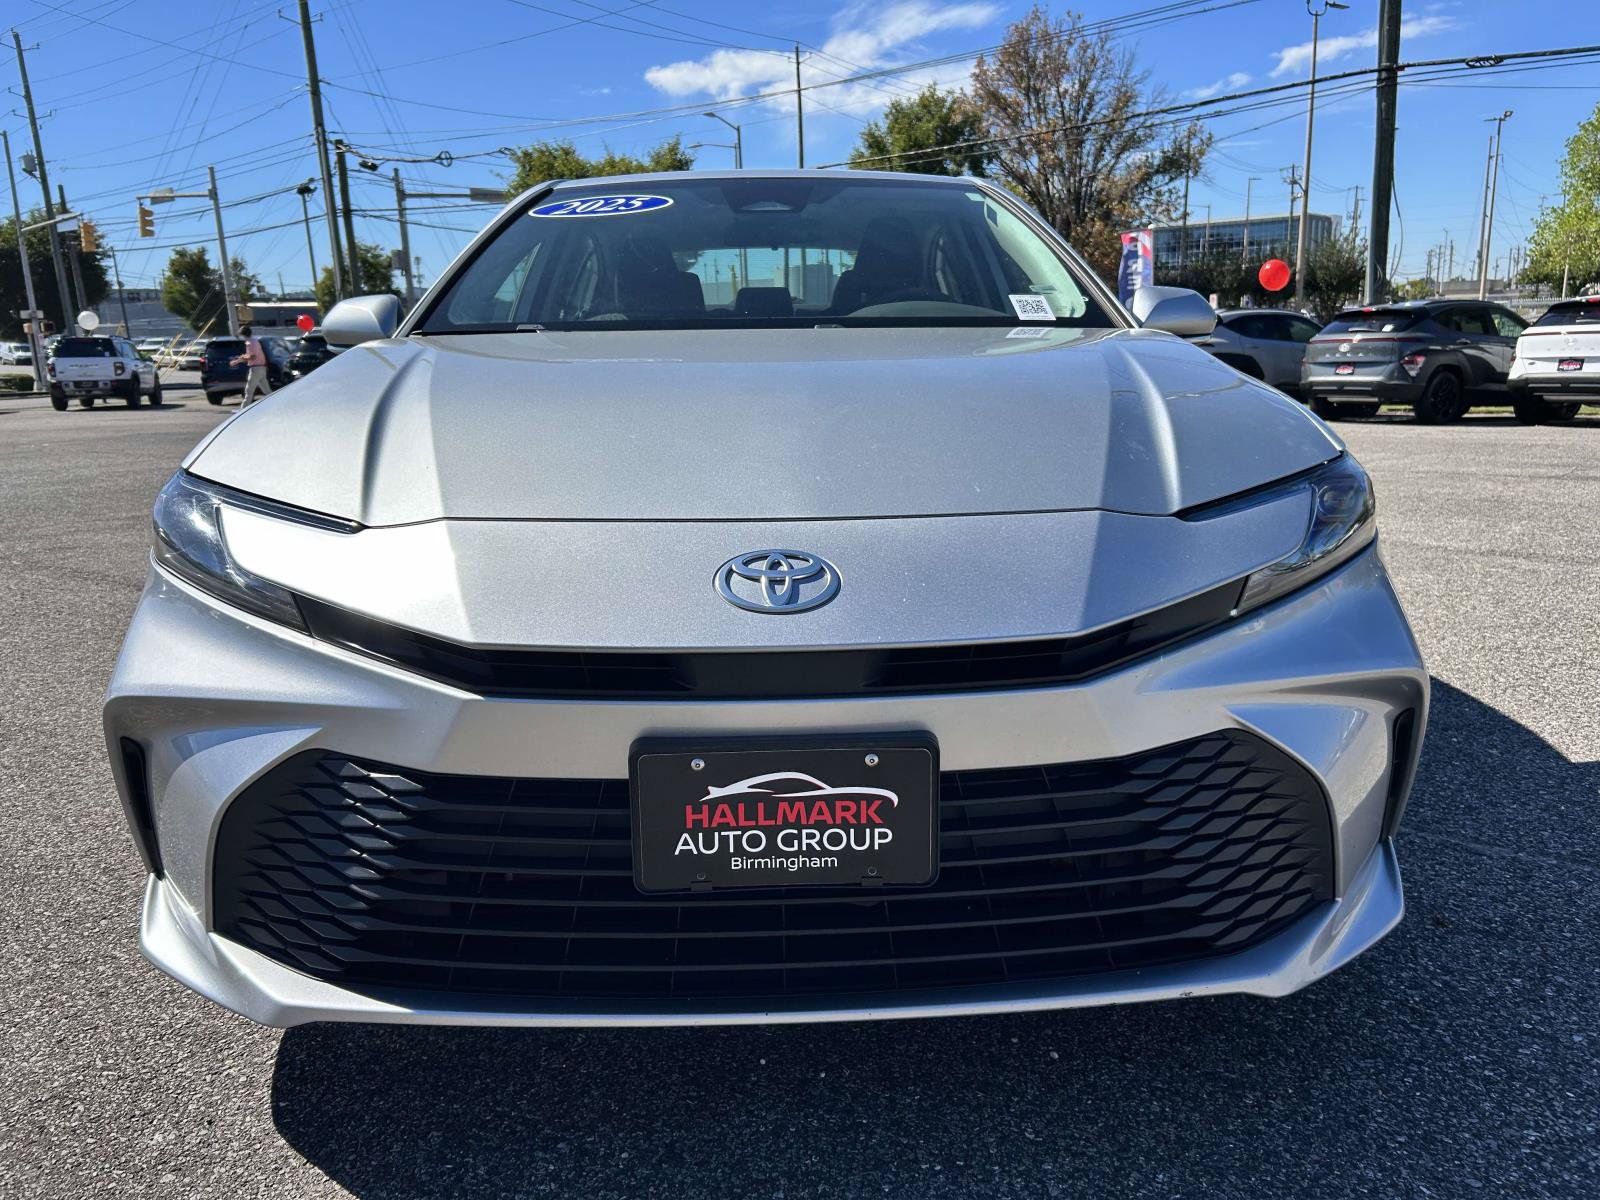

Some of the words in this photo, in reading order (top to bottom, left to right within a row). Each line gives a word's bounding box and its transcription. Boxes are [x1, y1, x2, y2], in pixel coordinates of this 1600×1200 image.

[550, 197, 651, 215] 2025
[685, 800, 883, 829] HALLMARK
[674, 830, 767, 855] AUTO
[776, 828, 893, 852] GROUP
[731, 855, 838, 872] Birmingham
